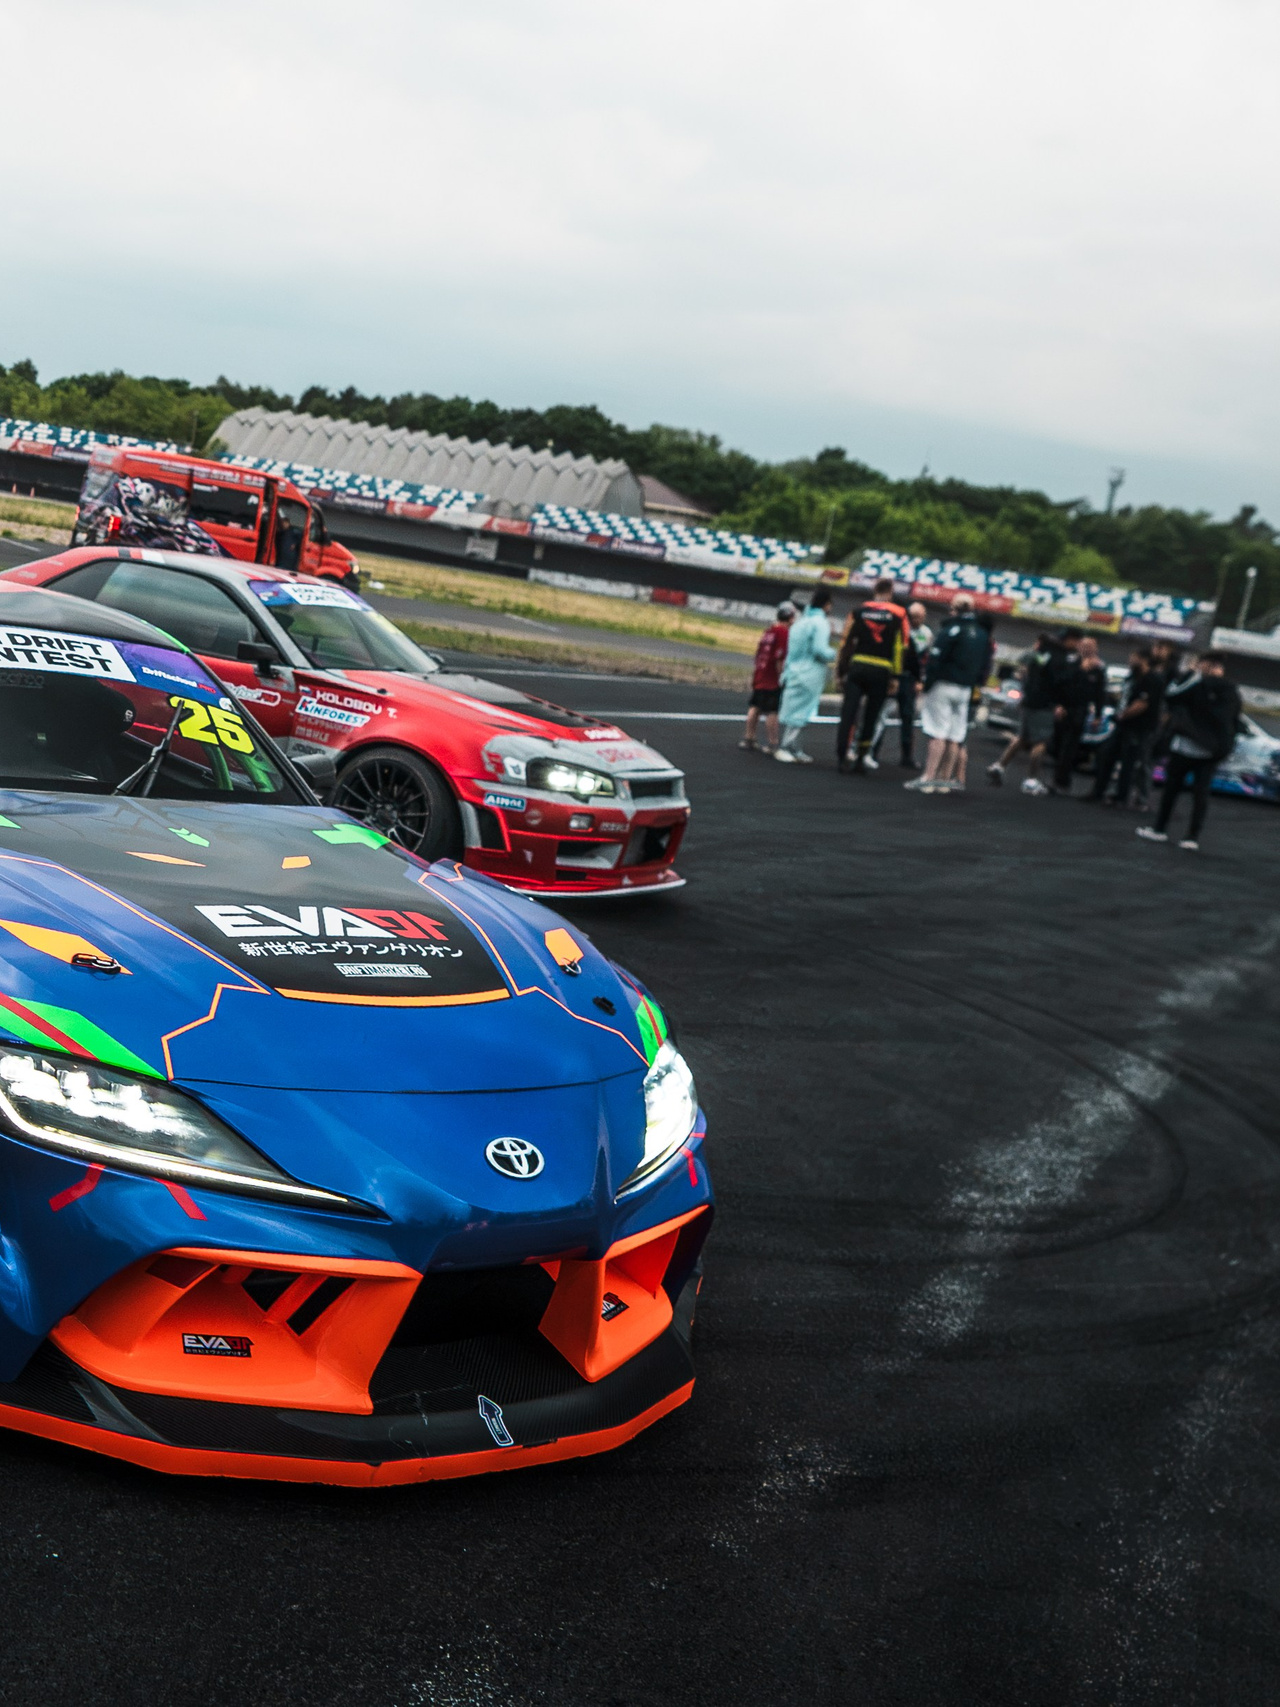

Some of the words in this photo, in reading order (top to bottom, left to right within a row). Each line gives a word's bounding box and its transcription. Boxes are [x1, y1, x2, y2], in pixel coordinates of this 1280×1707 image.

[5, 633, 103, 656] DRIFT
[299, 698, 366, 724] KINFOREST
[170, 696, 255, 754] 25
[237, 940, 464, 958] 新世紀エヴァンゲリオン
